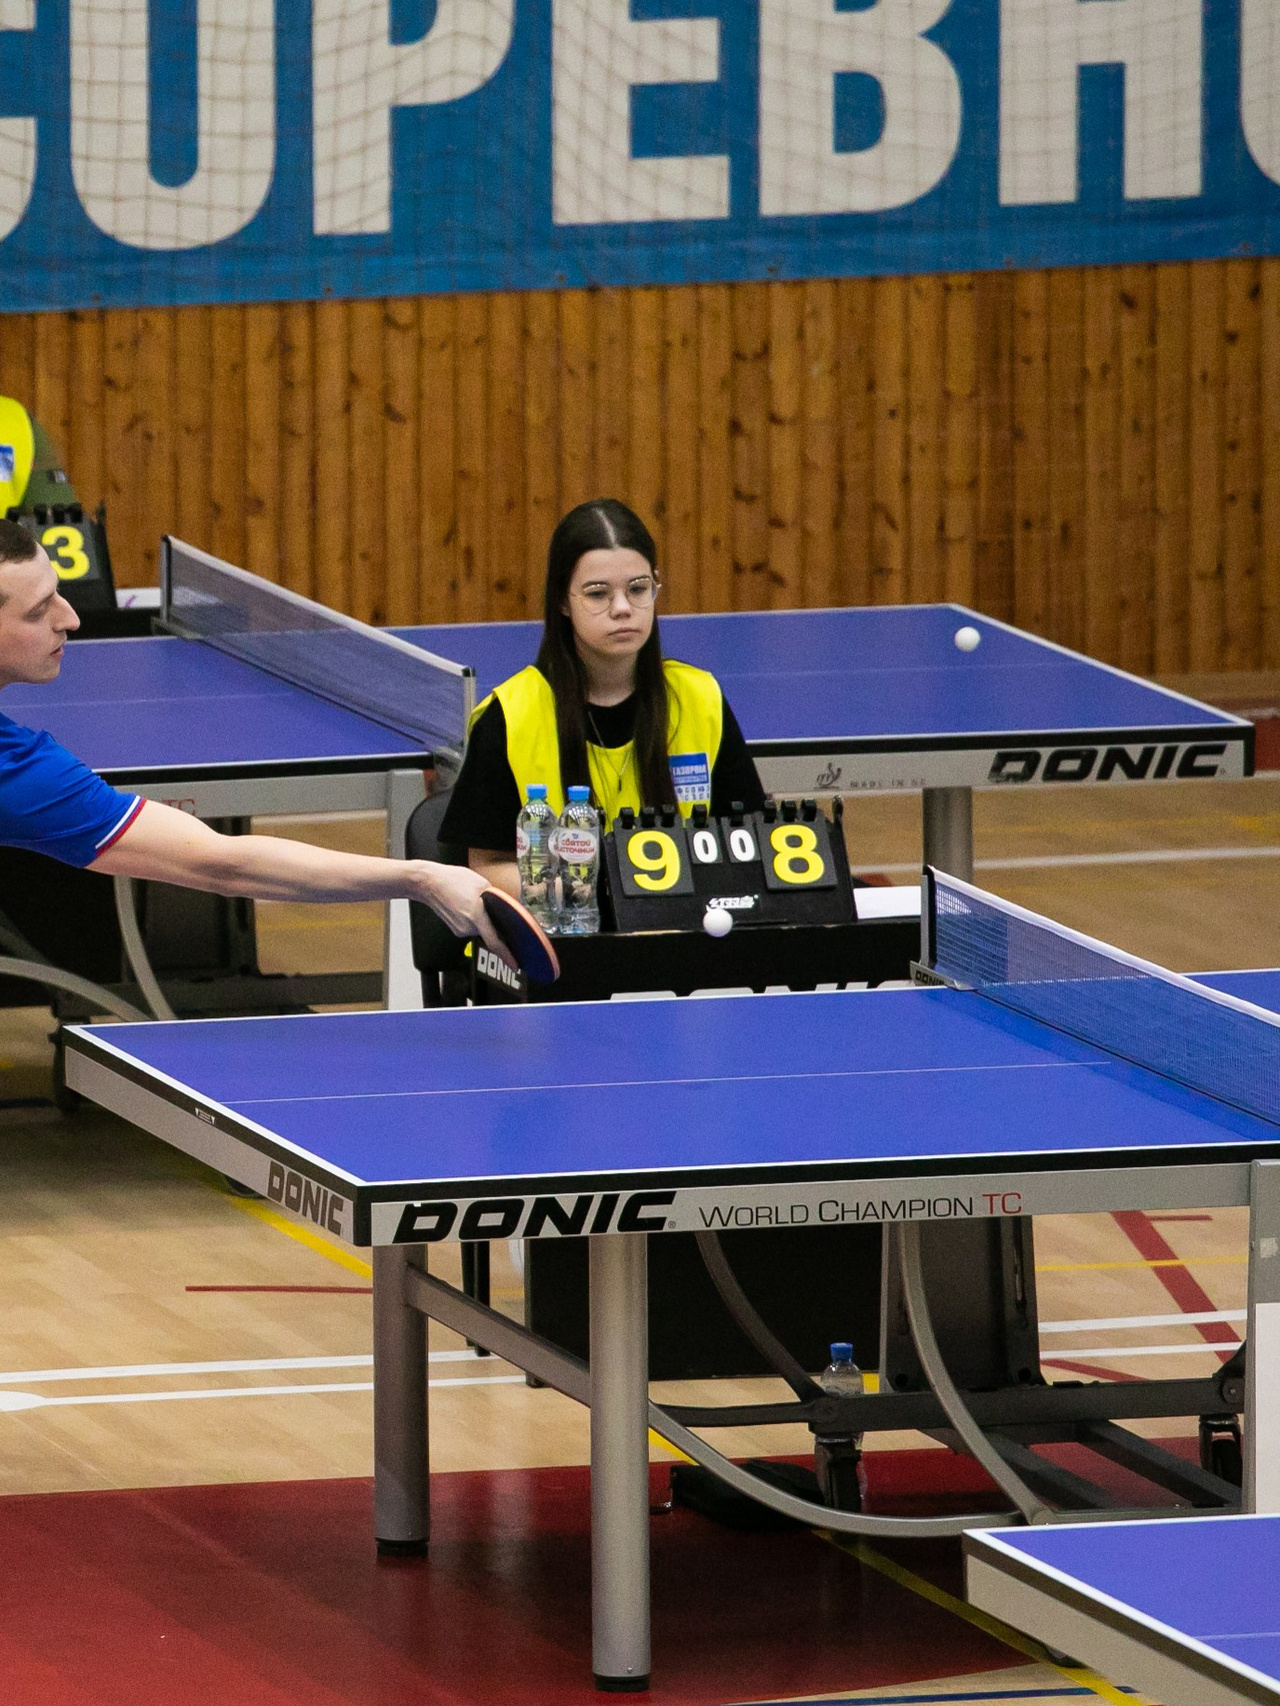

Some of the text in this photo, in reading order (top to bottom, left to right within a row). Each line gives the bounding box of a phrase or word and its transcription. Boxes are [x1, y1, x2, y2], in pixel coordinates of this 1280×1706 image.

[987, 743, 1227, 784] DONIC
[628, 830, 681, 892] 9
[693, 829, 755, 864] 0 0
[770, 824, 825, 884] 8
[267, 1160, 345, 1236] DONIC
[392, 1191, 1023, 1244] DONIC WORLD CHAMPION TC
